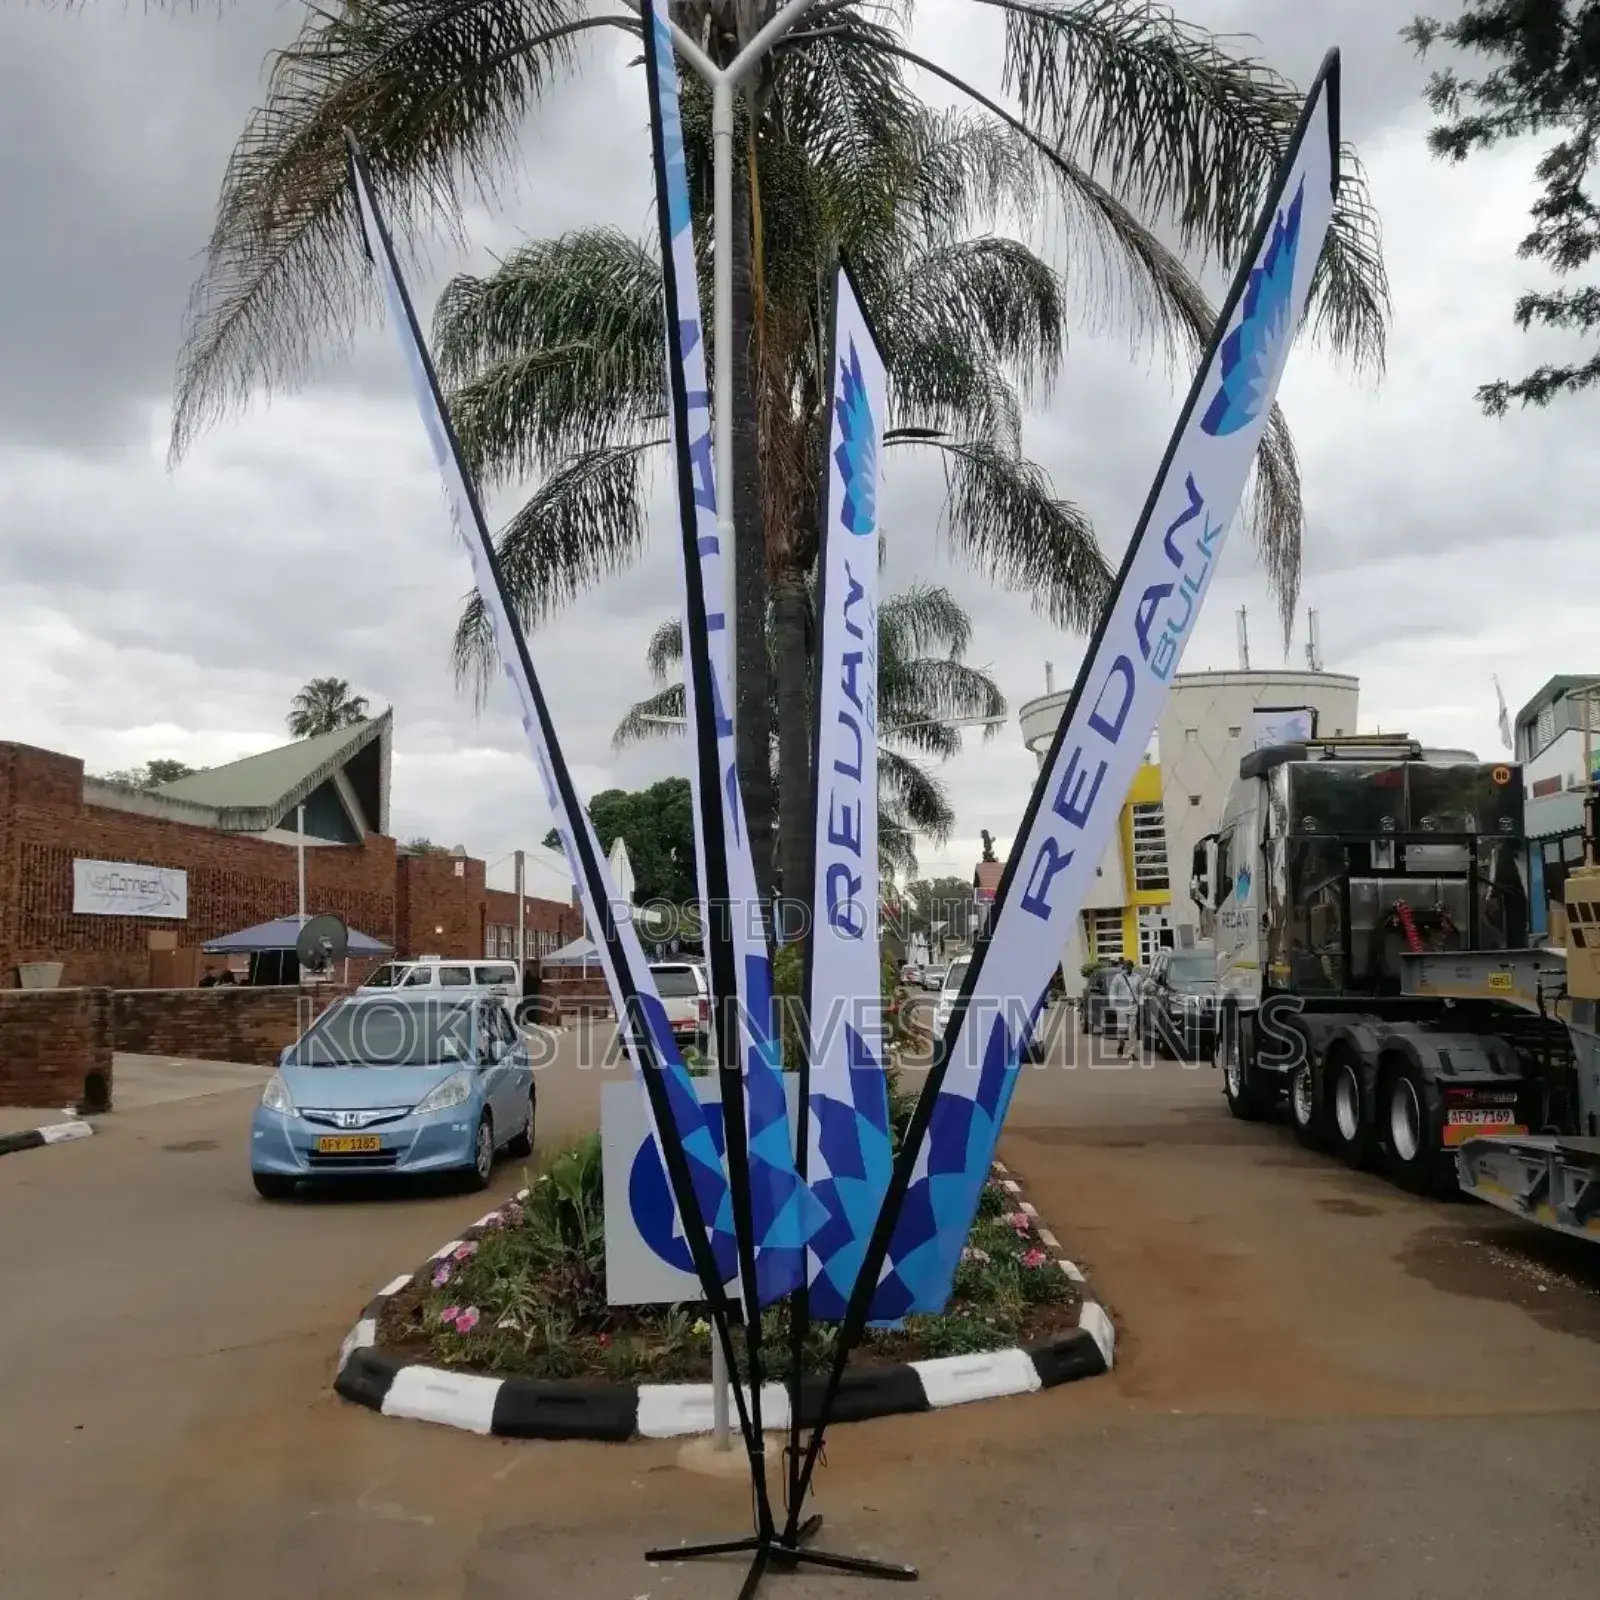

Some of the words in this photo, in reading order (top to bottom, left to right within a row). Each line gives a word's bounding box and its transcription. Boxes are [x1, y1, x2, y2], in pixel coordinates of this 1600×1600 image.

[826, 558, 864, 941] REDAN
[1020, 470, 1204, 921] REDAN
[1151, 510, 1224, 681] BULK
